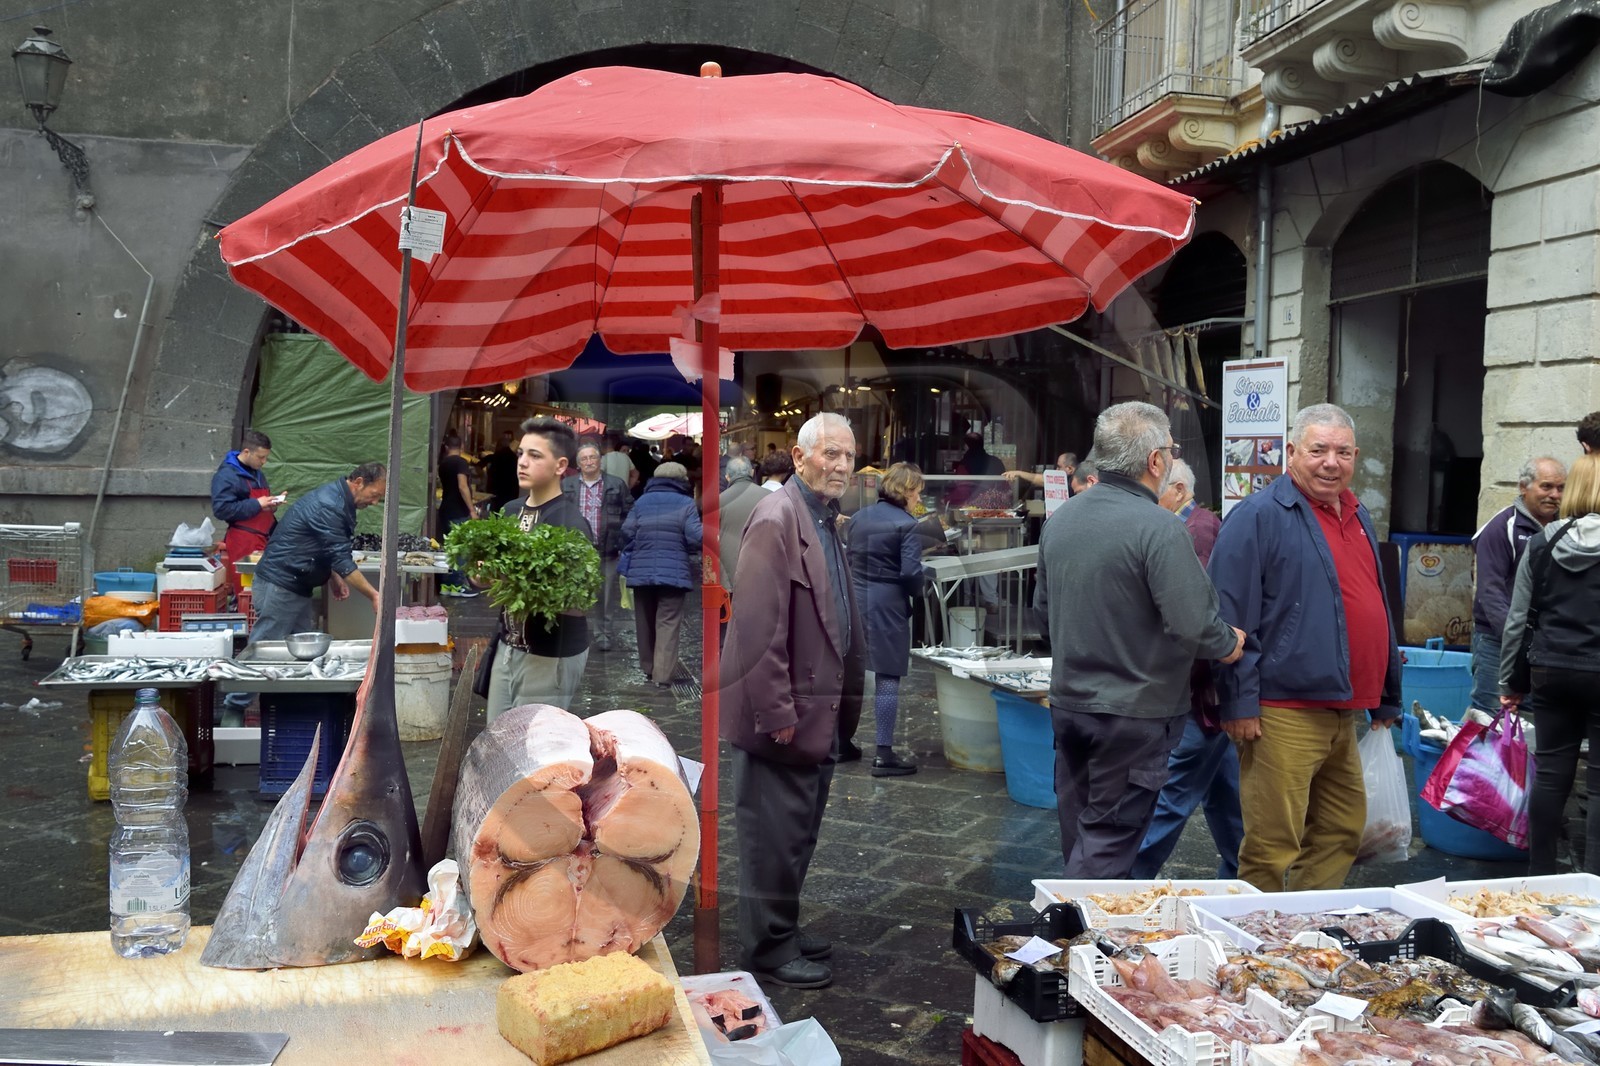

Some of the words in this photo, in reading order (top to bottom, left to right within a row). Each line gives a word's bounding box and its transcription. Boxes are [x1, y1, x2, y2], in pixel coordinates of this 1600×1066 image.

[1233, 376, 1274, 395] Stocco
[1248, 392, 1260, 410] &
[1227, 401, 1280, 423] Baccalà
